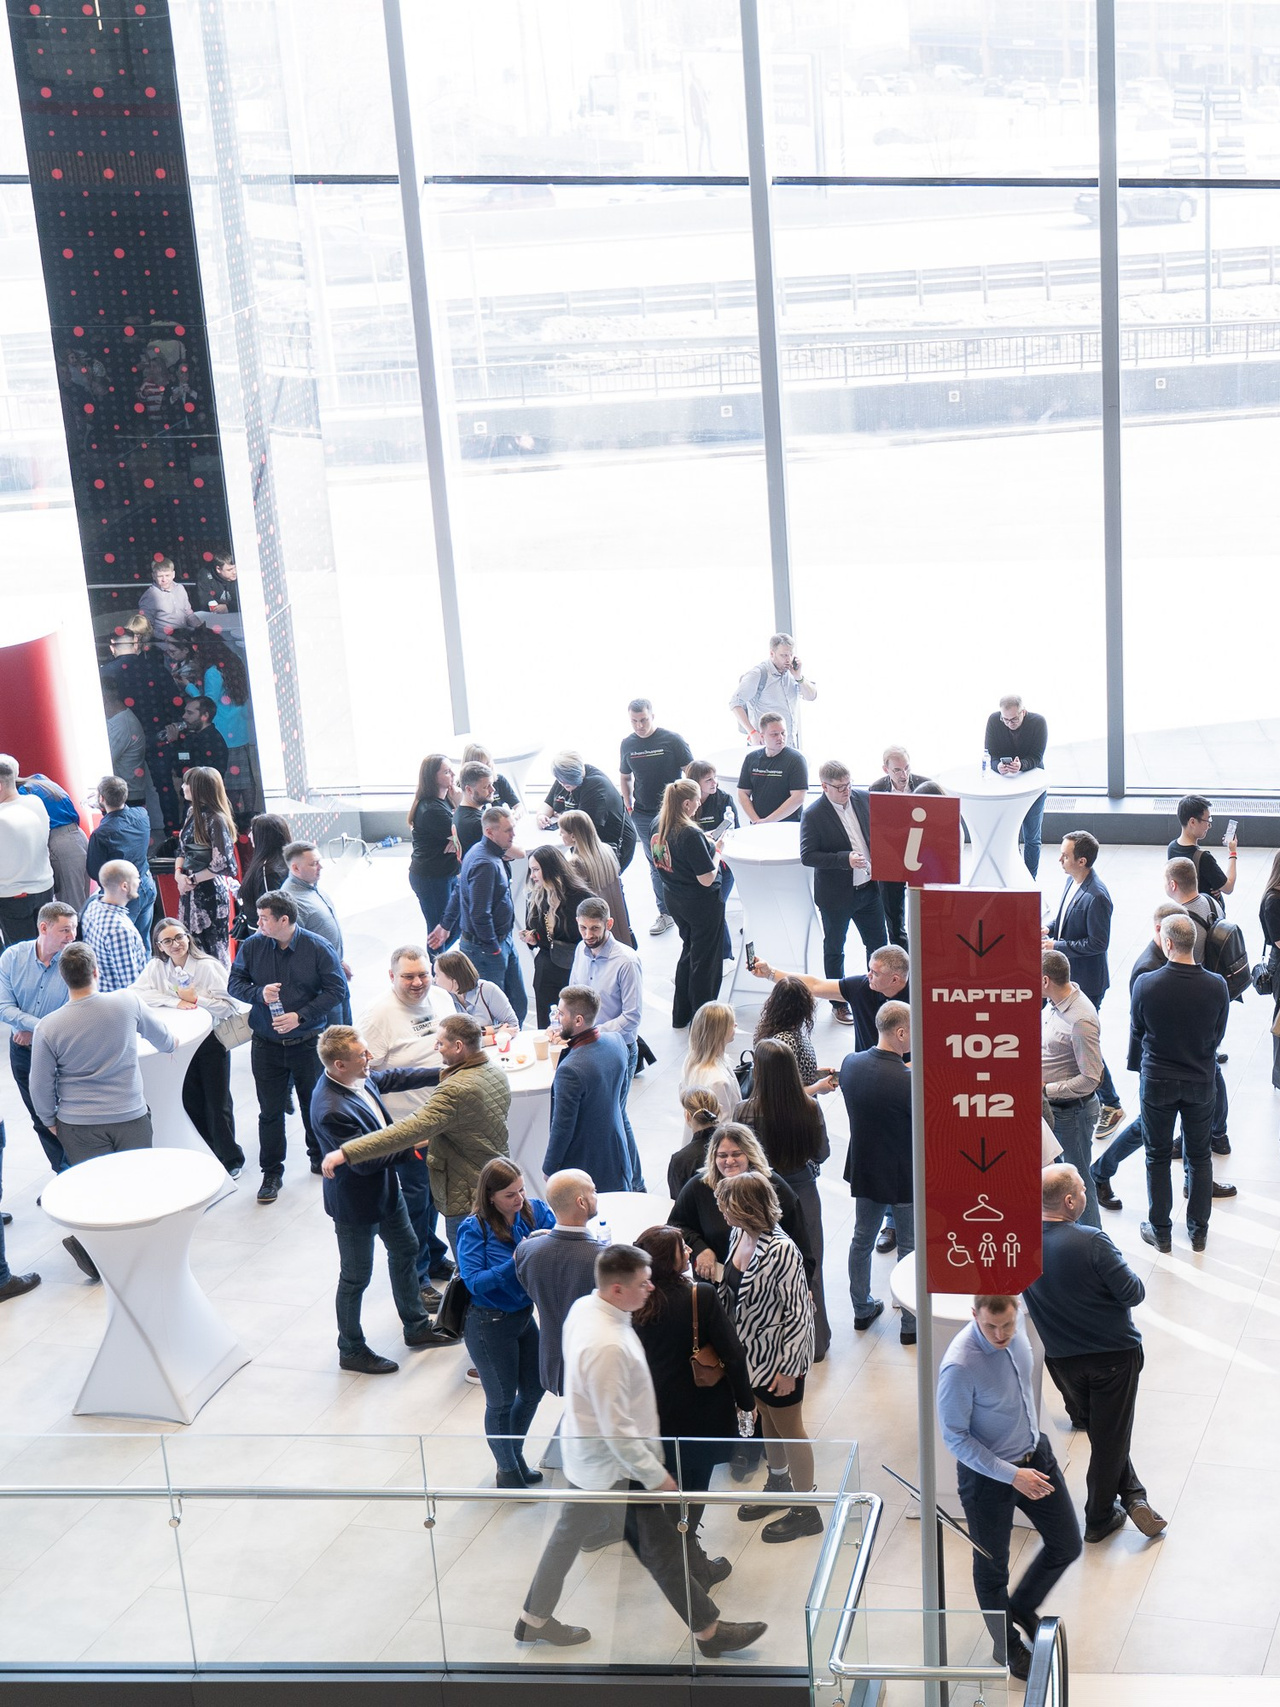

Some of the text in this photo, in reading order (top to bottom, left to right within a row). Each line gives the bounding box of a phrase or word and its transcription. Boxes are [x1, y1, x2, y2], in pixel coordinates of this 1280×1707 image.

[932, 988, 1033, 1003] ПАРТЕР
[946, 1034, 1020, 1059] 102
[952, 1093, 1014, 1118] 112
